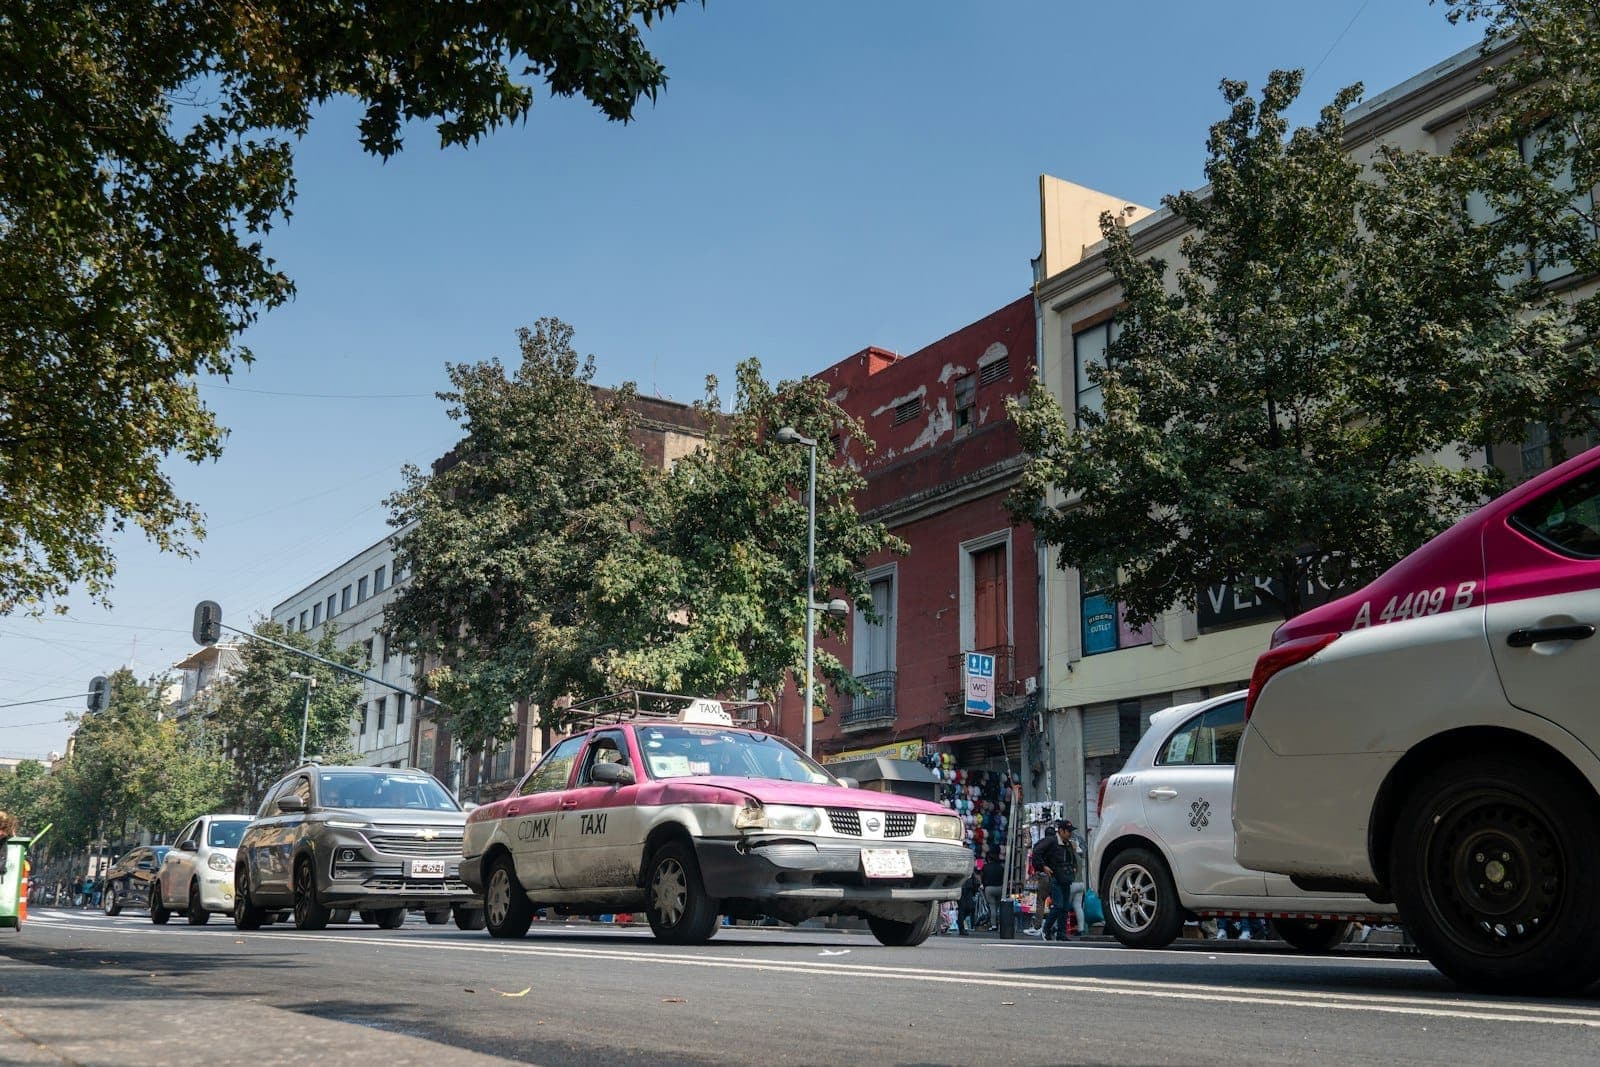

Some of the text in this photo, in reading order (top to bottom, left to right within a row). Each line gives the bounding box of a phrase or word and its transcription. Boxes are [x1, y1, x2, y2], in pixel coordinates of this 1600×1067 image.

[1352, 581, 1477, 630] A 4409 B
[1090, 622, 1111, 633] OUTLET
[971, 683, 986, 692] WC
[699, 703, 720, 714] TAXI
[517, 817, 551, 840] CDMX
[580, 813, 608, 835] TAXI
